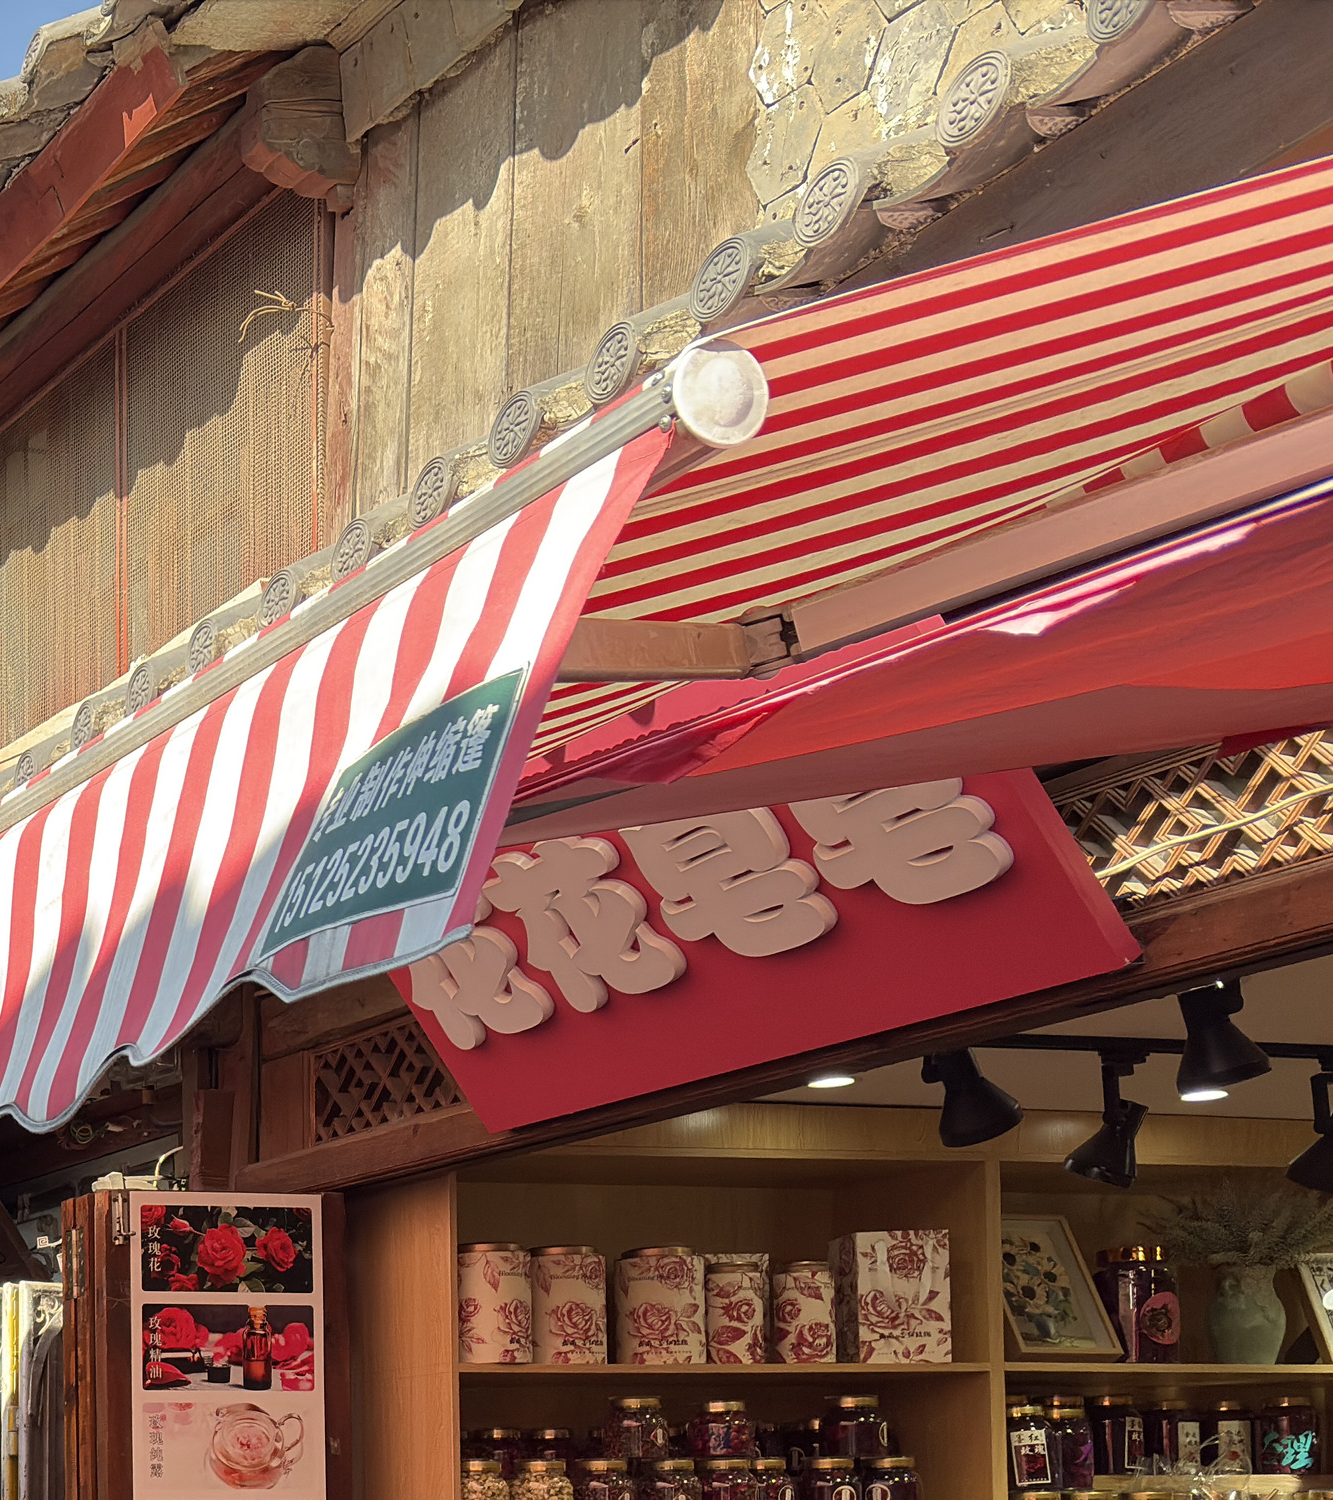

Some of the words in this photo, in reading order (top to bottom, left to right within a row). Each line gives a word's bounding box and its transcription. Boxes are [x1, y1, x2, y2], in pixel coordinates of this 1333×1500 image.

[275, 800, 470, 933] 15125235948
[147, 1225, 162, 1272] 玫瑰花
[148, 1316, 163, 1379] 玫瑰精油
[148, 1415, 164, 1478] 玫瑰纯露
